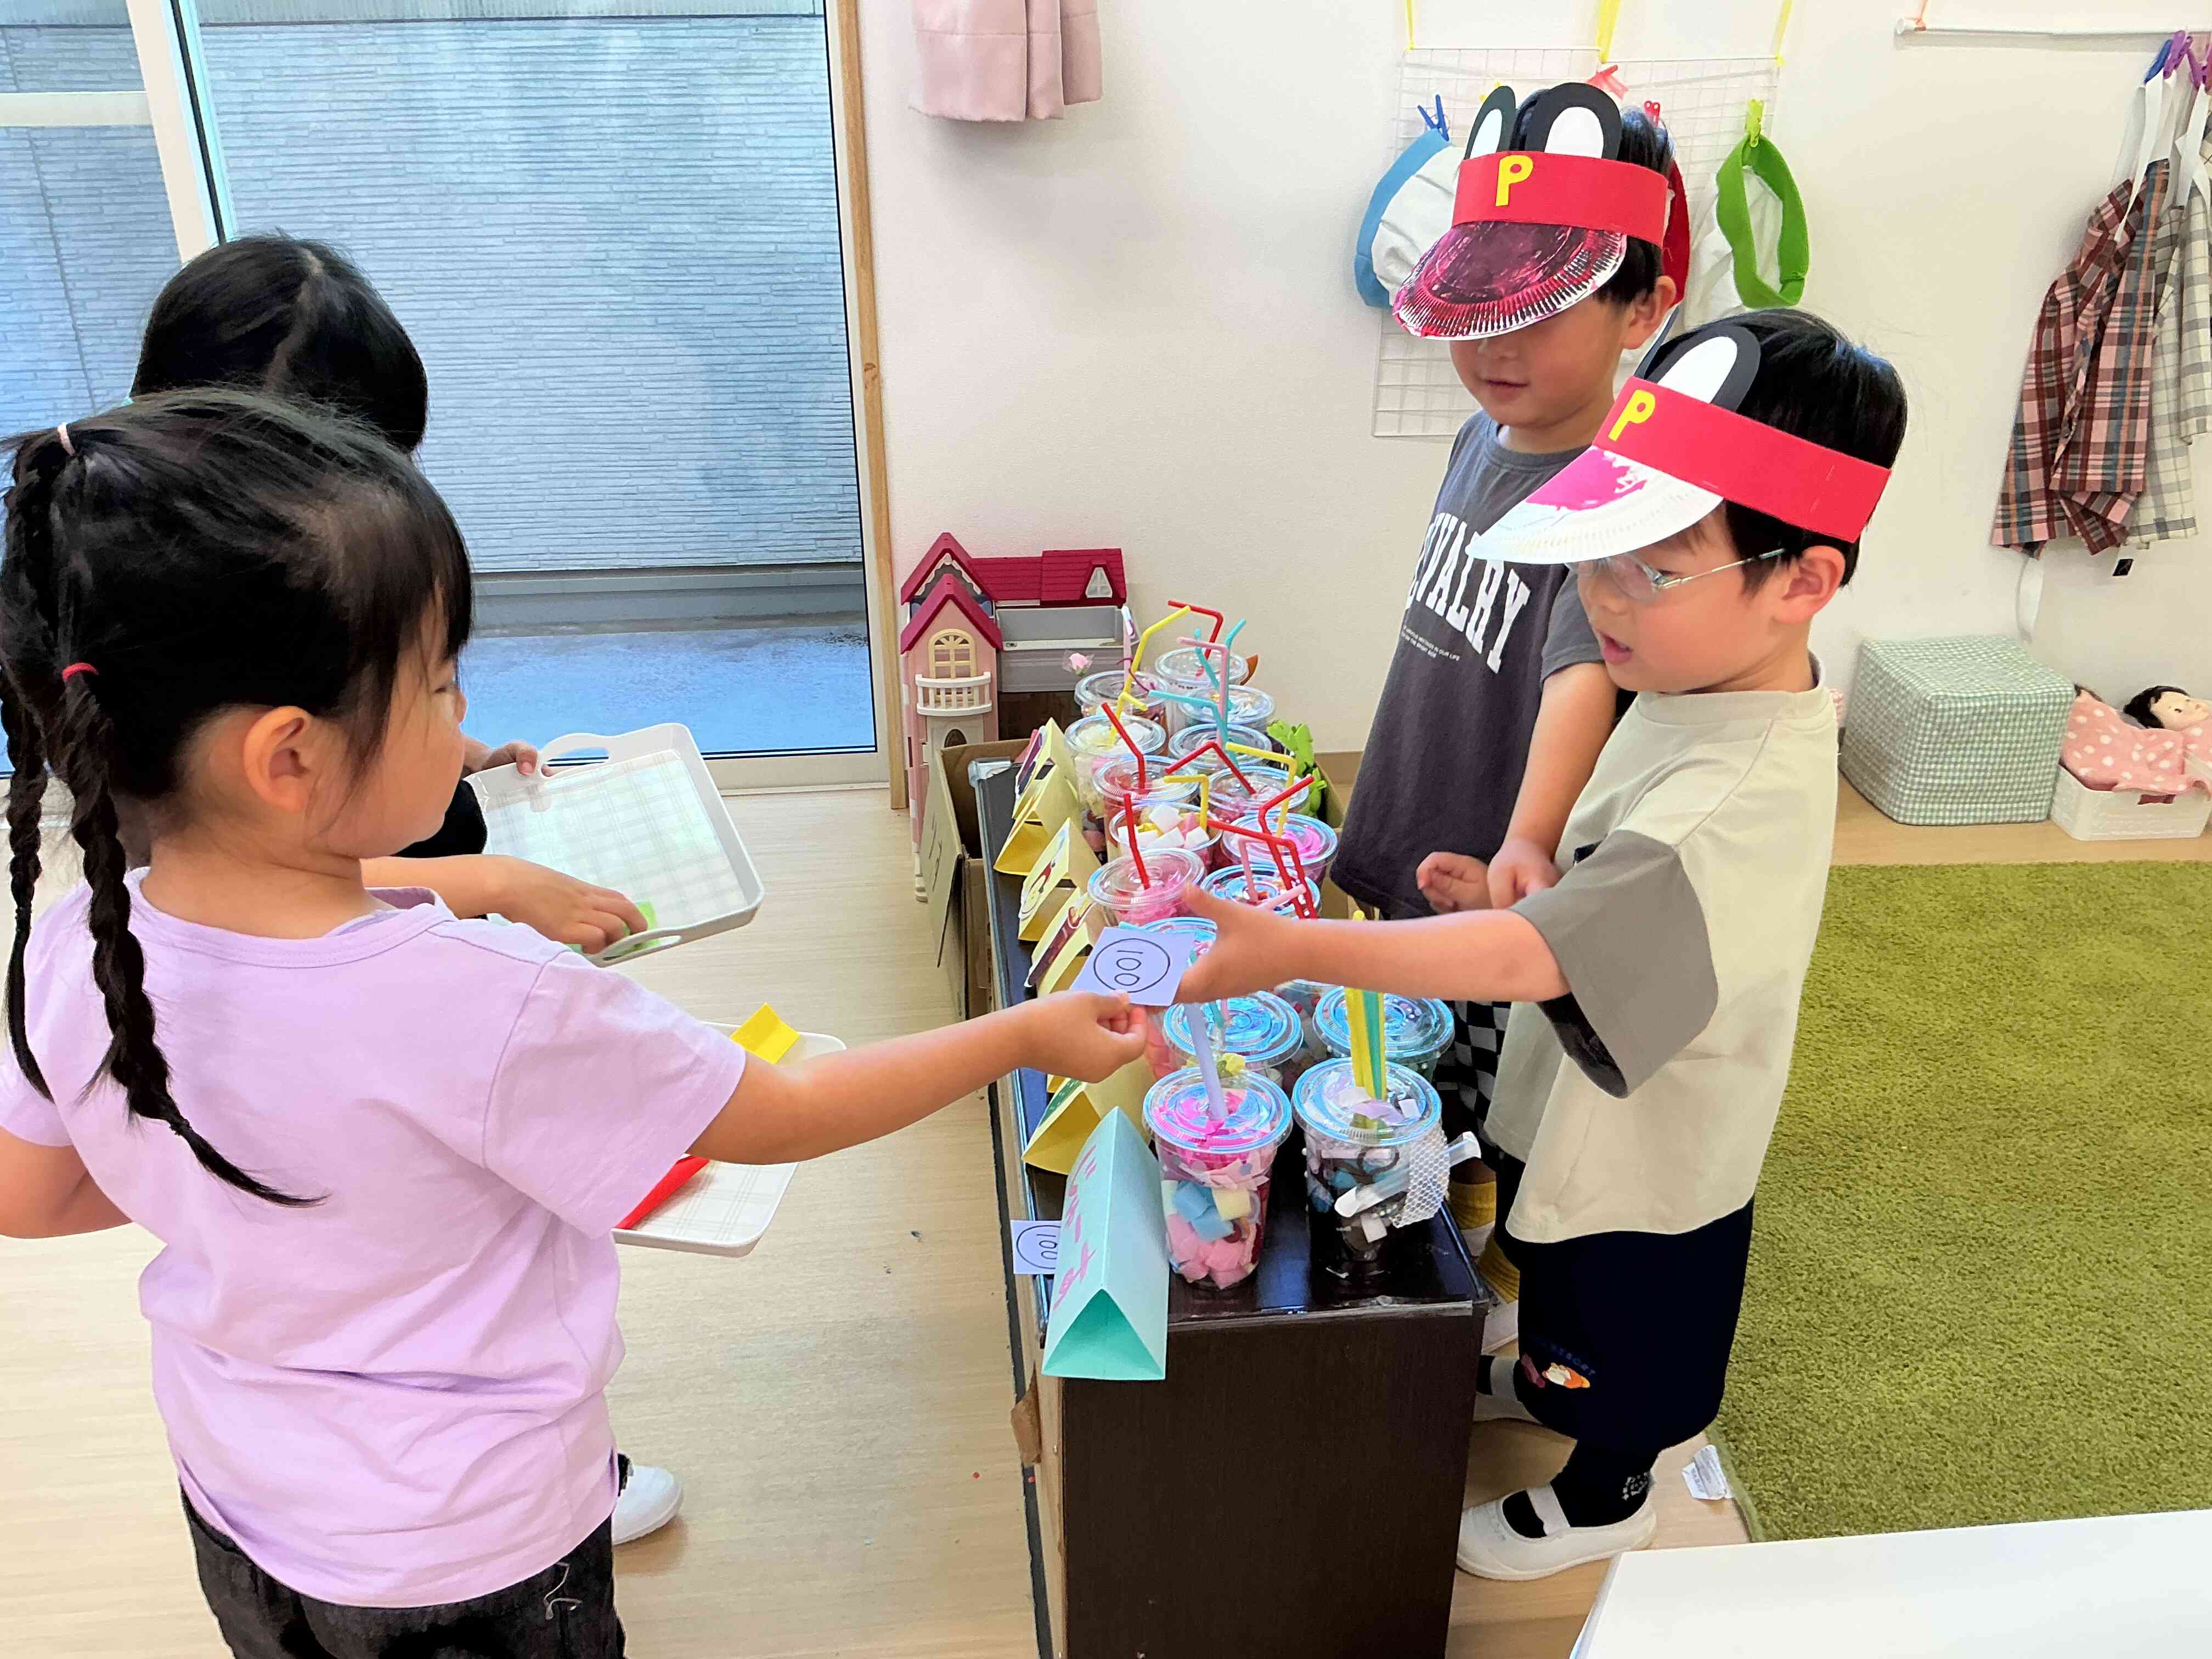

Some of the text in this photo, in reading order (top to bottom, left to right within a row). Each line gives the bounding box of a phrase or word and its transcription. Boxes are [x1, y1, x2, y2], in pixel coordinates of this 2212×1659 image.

[1495, 155, 1533, 207] P
[1608, 390, 1656, 442] P
[1448, 653, 1460, 662] LIFE
[1114, 950, 1144, 986] 100
